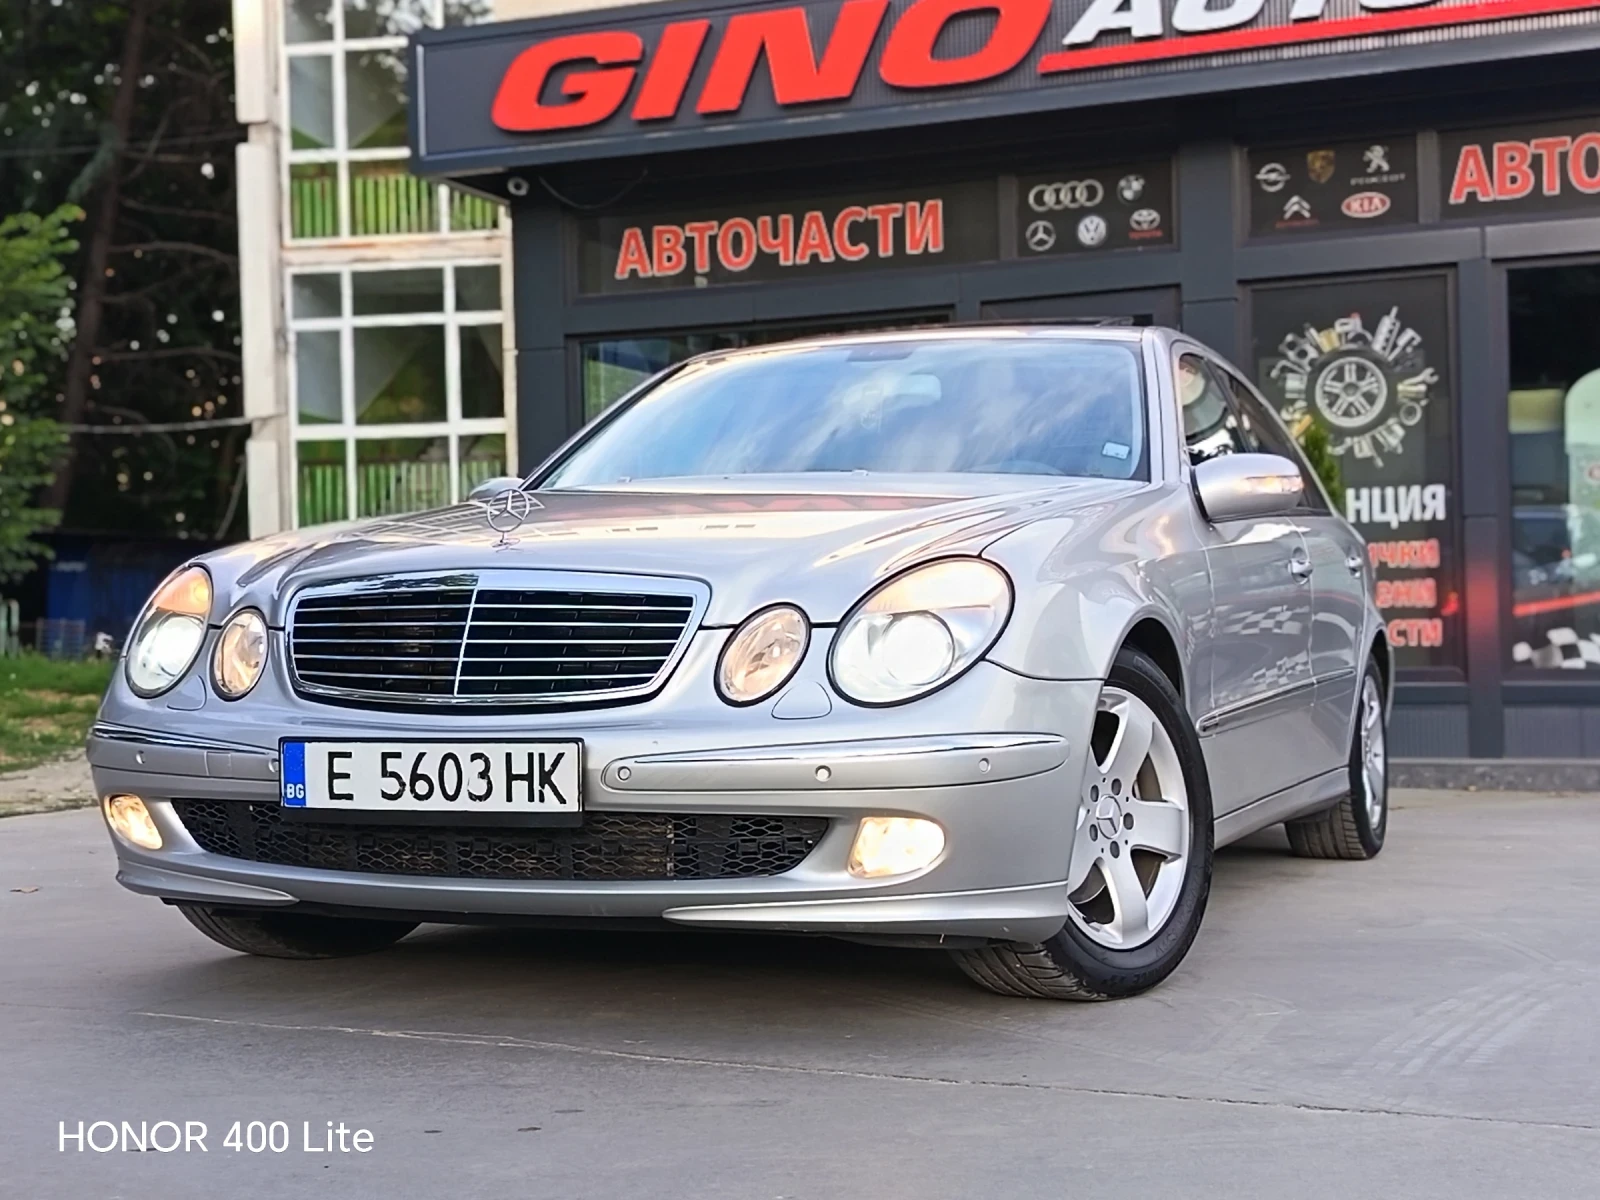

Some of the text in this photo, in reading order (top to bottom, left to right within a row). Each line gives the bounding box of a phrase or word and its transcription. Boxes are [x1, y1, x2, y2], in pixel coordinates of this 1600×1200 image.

[490, 0, 1051, 133] GINO
[1350, 196, 1383, 213] KIA
[614, 199, 944, 280] АВТОЧАСТИ
[286, 783, 305, 799] BG
[327, 751, 354, 801] E
[380, 751, 493, 802] 5603
